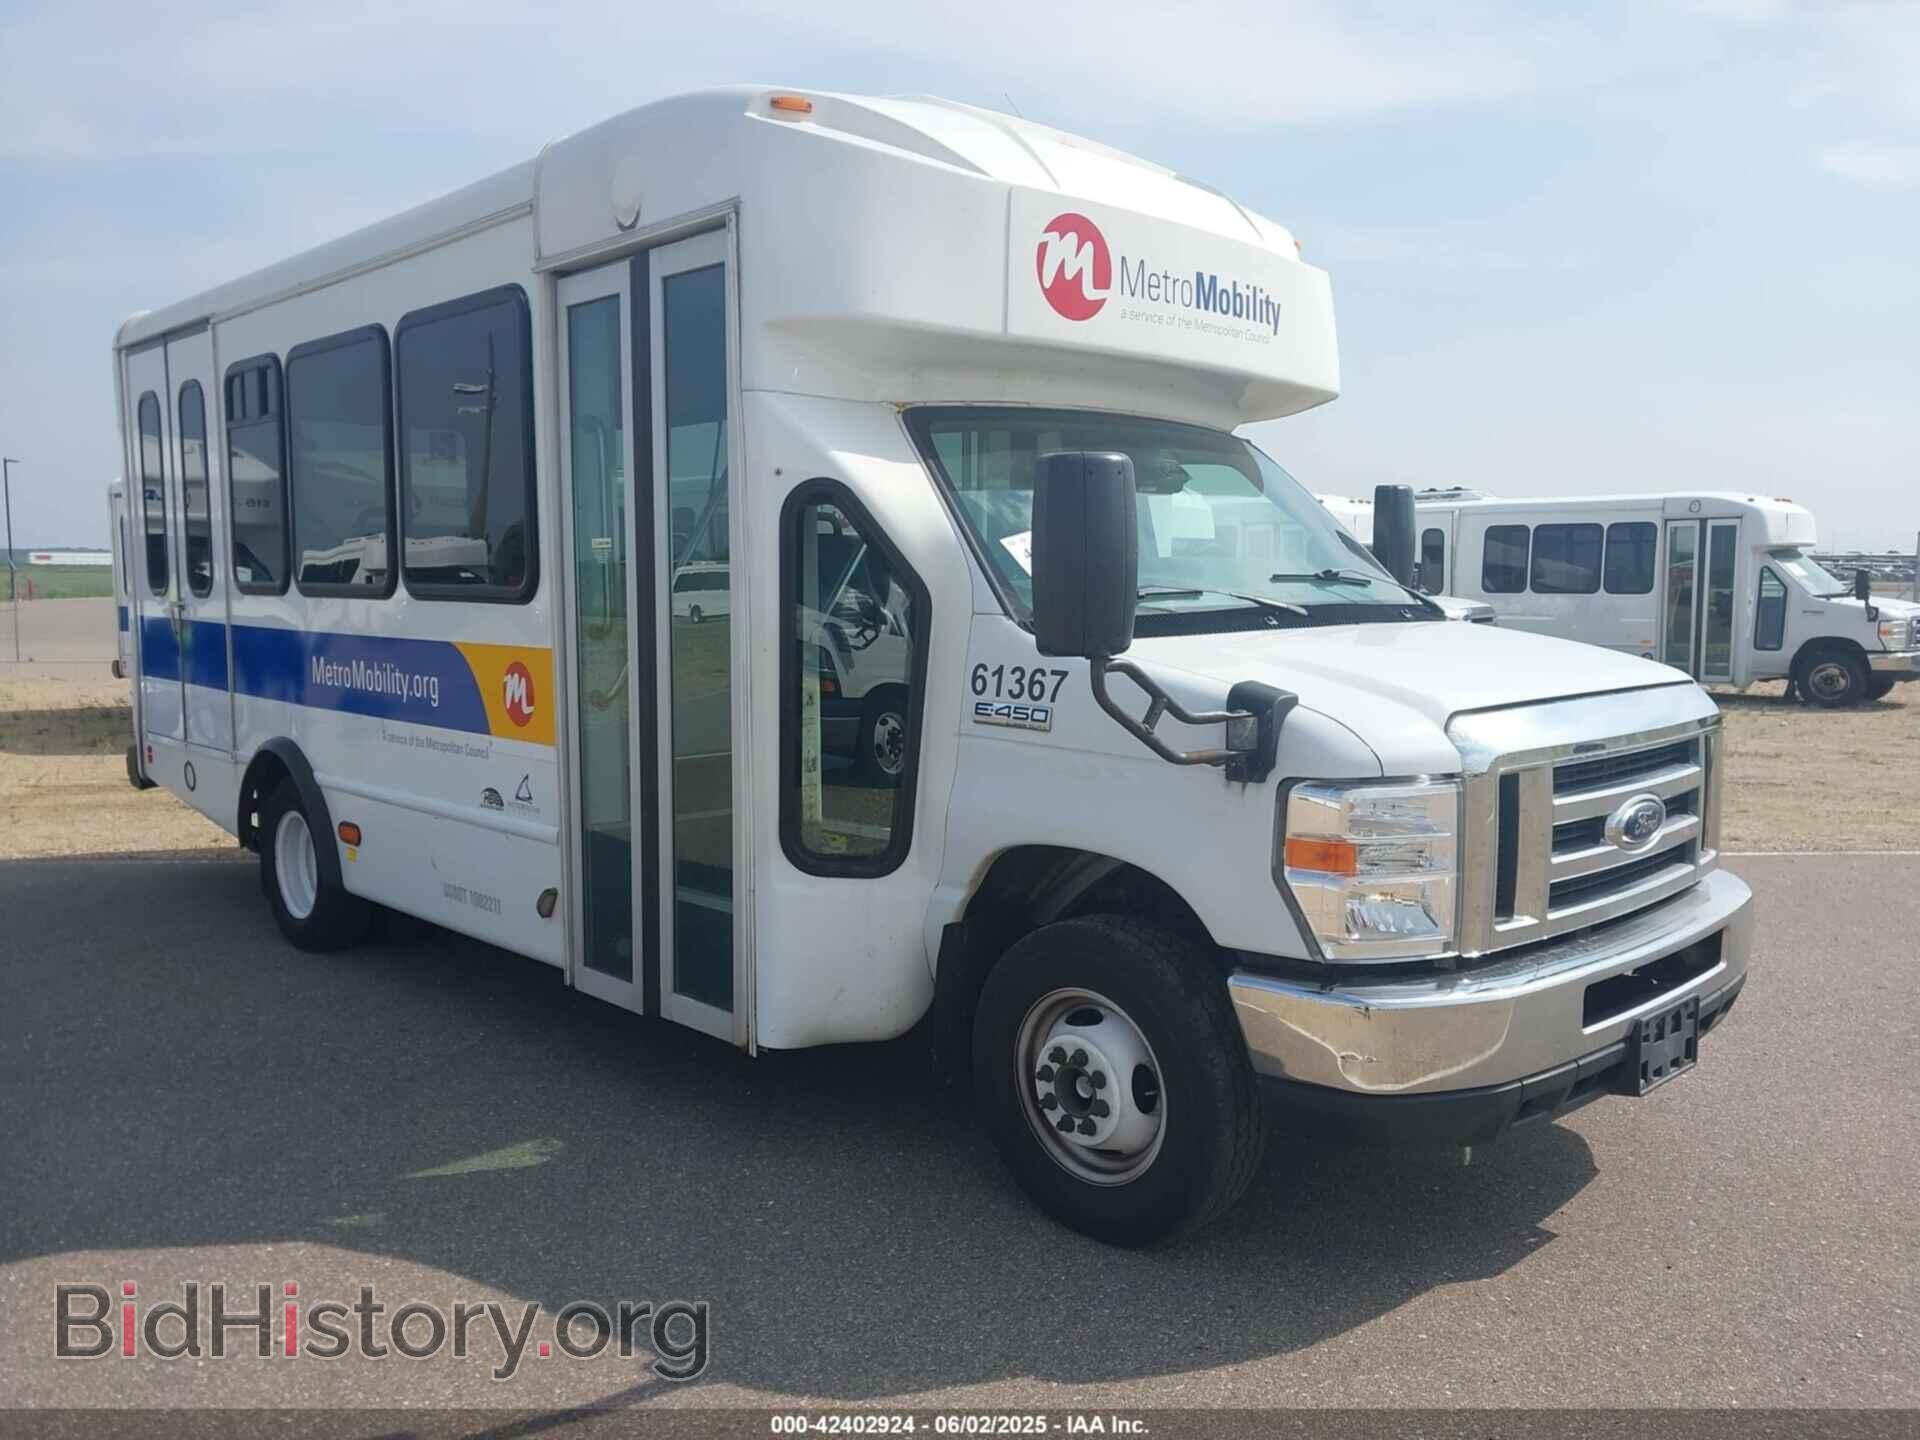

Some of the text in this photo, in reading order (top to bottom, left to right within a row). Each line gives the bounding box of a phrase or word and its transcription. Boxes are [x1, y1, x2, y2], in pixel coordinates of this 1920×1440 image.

[1120, 255, 1282, 335] MetroMobility
[1129, 310, 1164, 326] service
[1166, 313, 1176, 326] of
[1178, 315, 1193, 329] the
[1194, 318, 1244, 341] Metropolitan
[312, 655, 439, 707] MetroMobility.org
[970, 663, 1069, 703] 61367
